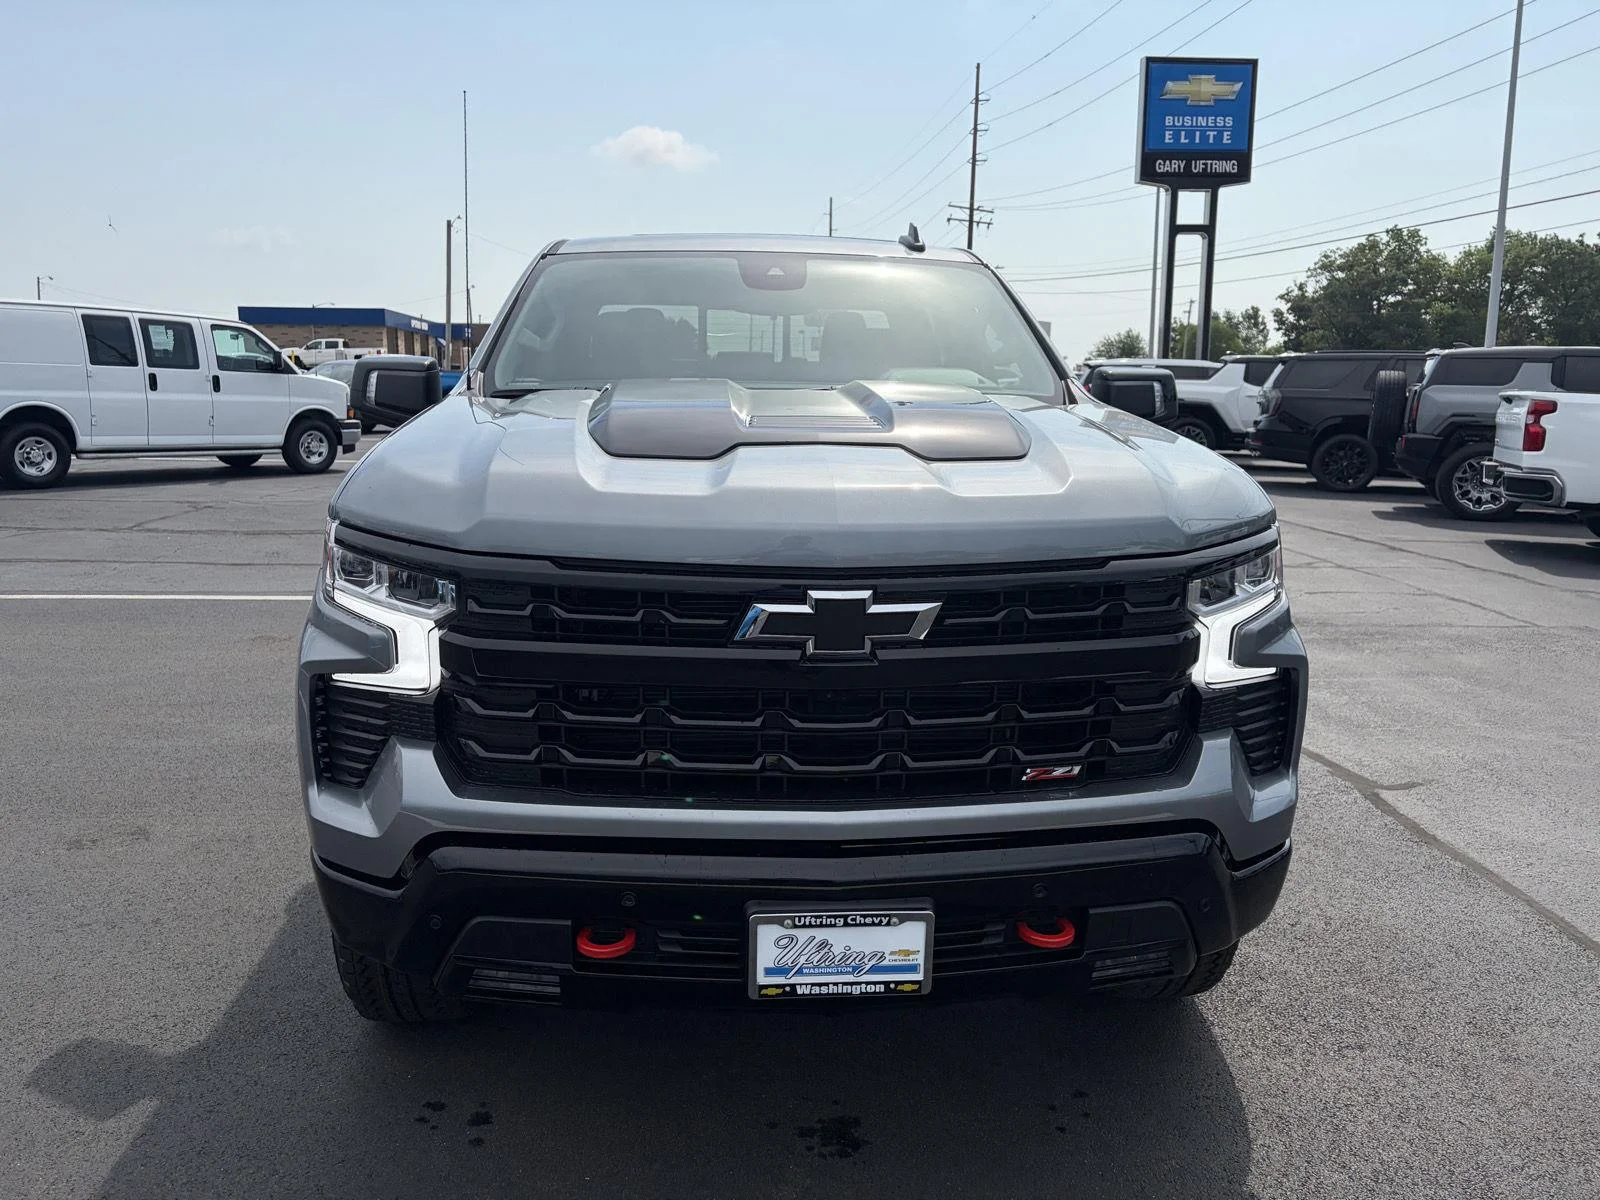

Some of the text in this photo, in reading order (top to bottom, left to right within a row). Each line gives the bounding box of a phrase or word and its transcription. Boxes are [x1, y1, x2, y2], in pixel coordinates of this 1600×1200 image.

[1165, 116, 1233, 127] BUSINESS
[1164, 131, 1232, 144] ELITE
[1155, 159, 1238, 173] GARY UFTRING
[794, 915, 889, 926] Uftring Chevy
[773, 934, 887, 979] Uftring
[796, 983, 885, 995] Washington
